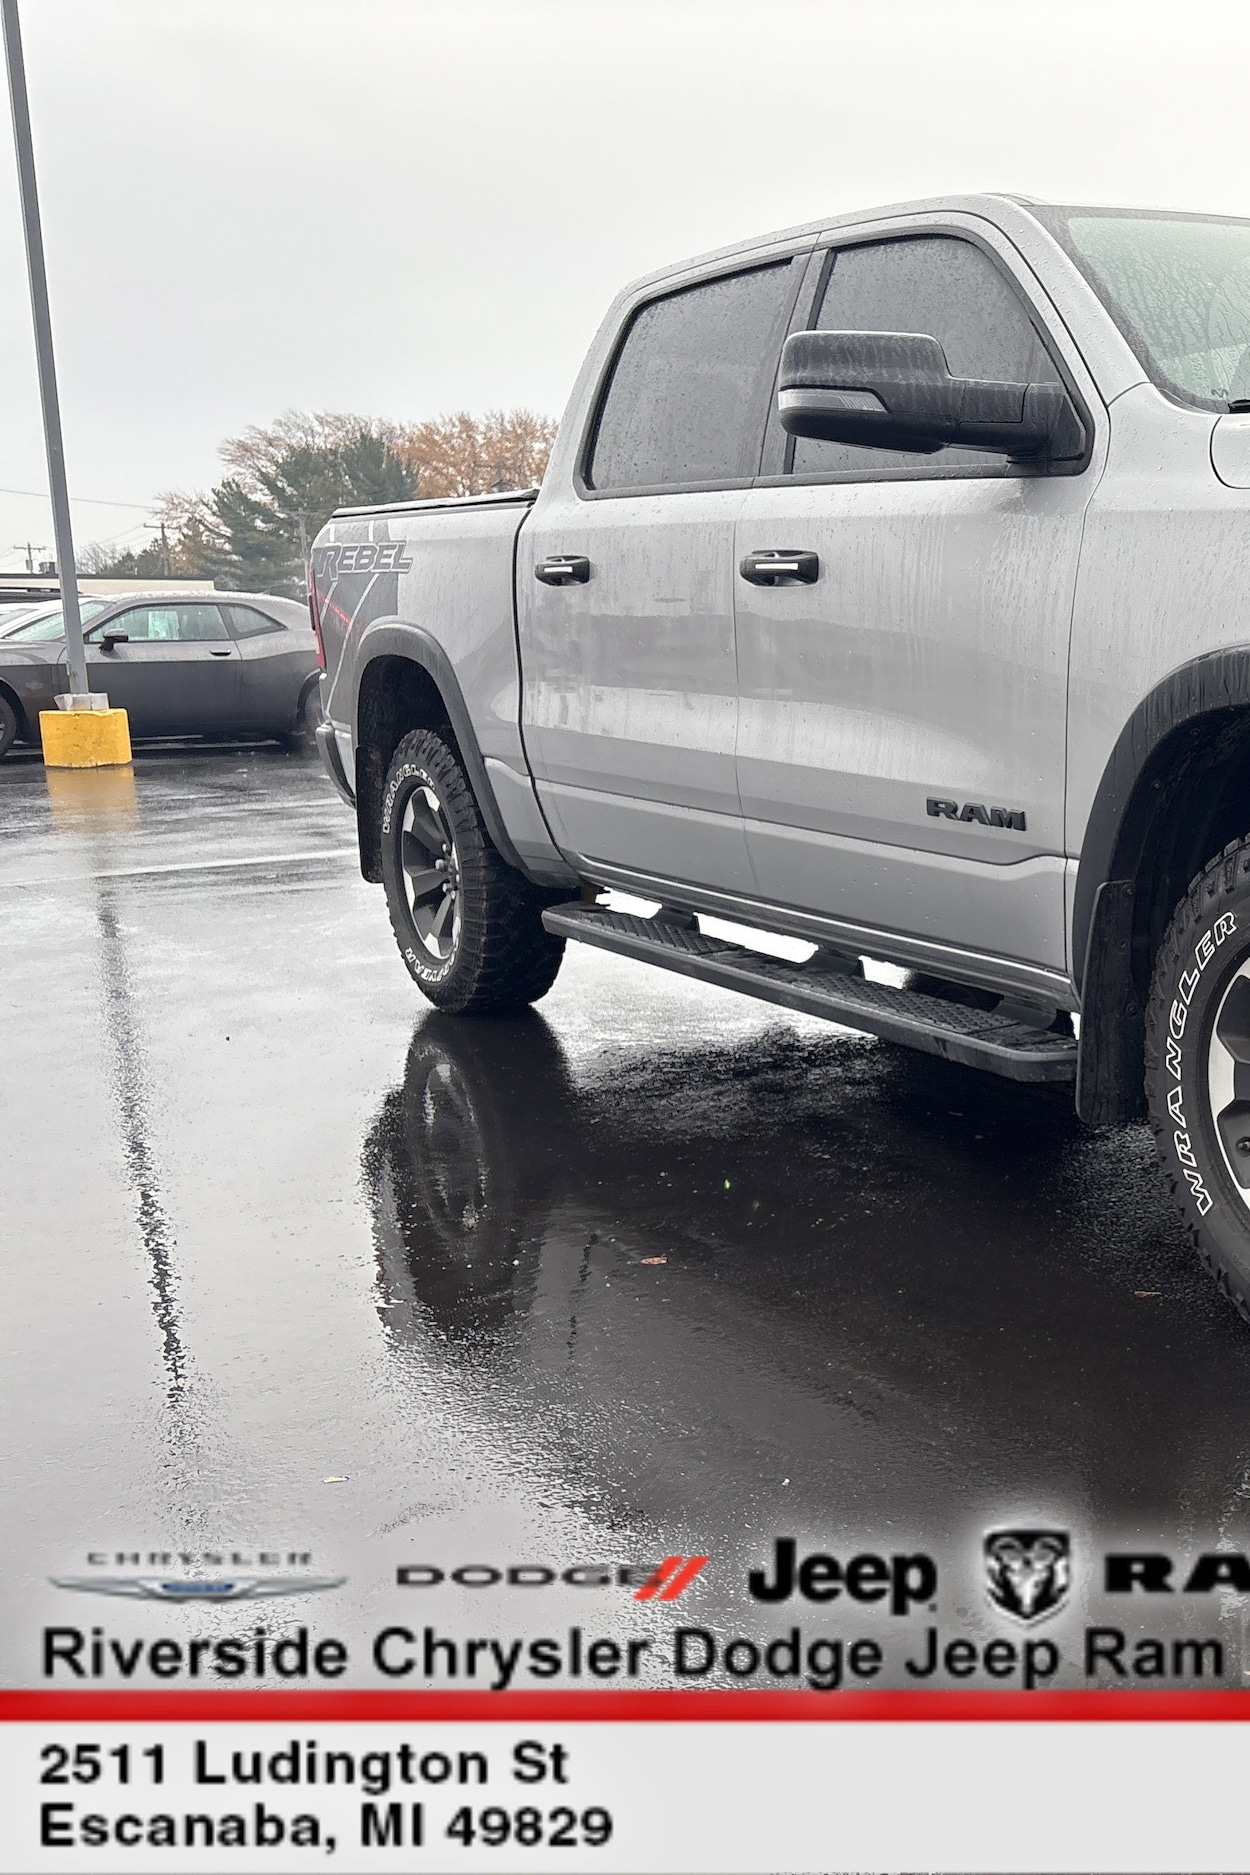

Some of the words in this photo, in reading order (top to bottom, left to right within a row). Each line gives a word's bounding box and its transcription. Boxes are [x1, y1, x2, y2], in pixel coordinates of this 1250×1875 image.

[313, 541, 414, 582] REBEL
[926, 796, 1027, 832] RAM
[1165, 911, 1239, 1217] WRANGLER
